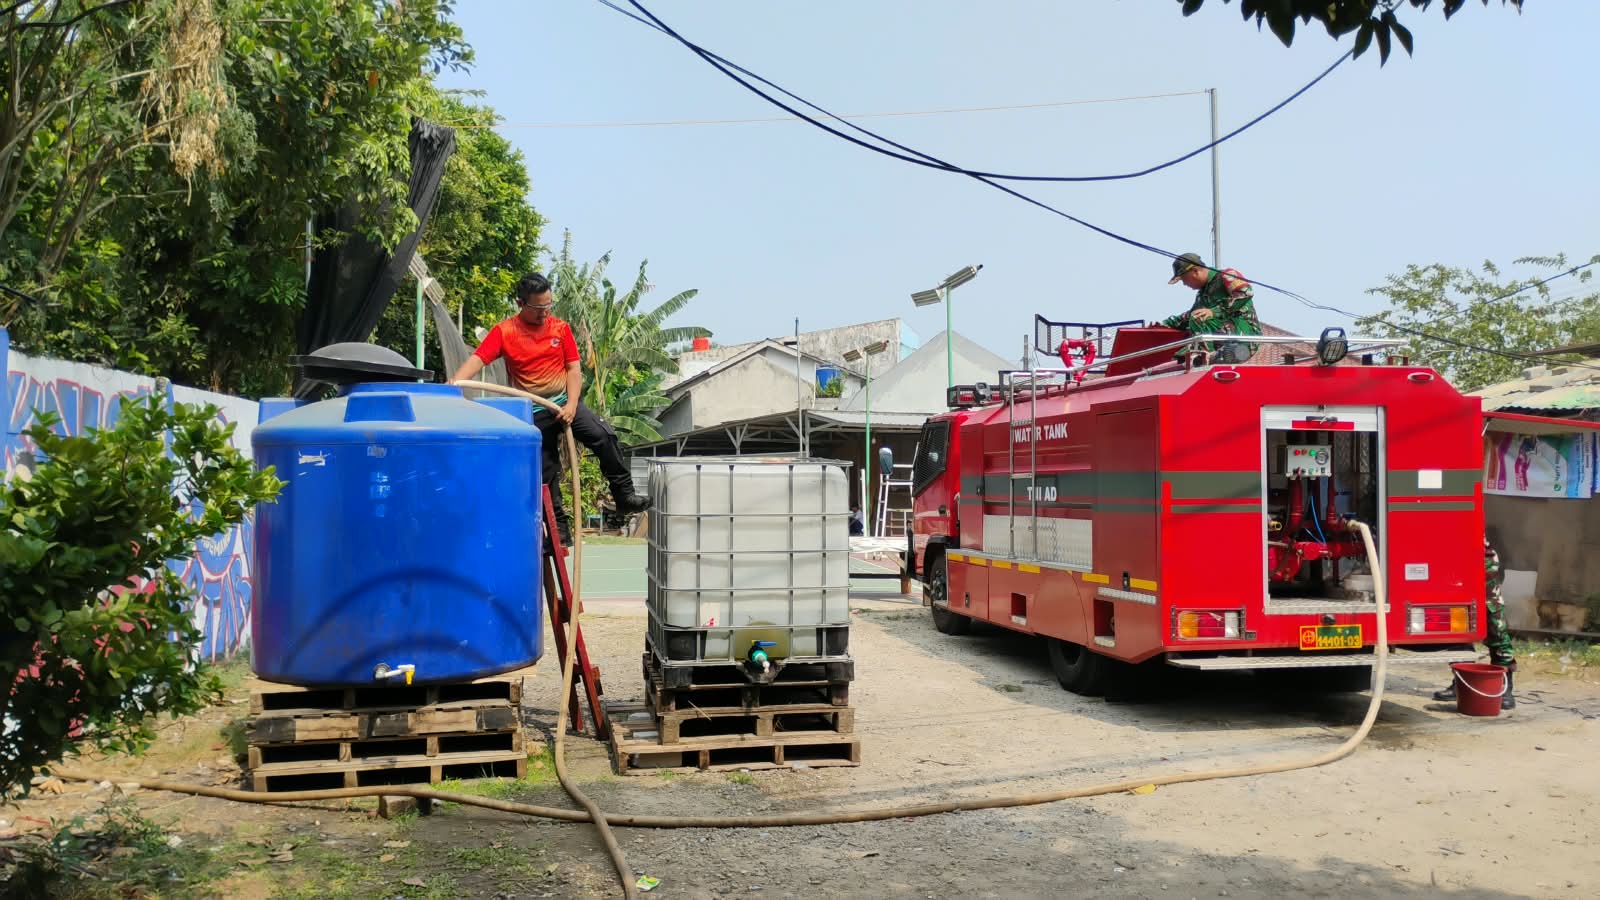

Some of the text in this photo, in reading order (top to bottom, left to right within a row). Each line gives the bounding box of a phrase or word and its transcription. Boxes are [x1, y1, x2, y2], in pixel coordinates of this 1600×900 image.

[1014, 422, 1068, 443] WATR TANK
[1044, 486, 1057, 502] AD
